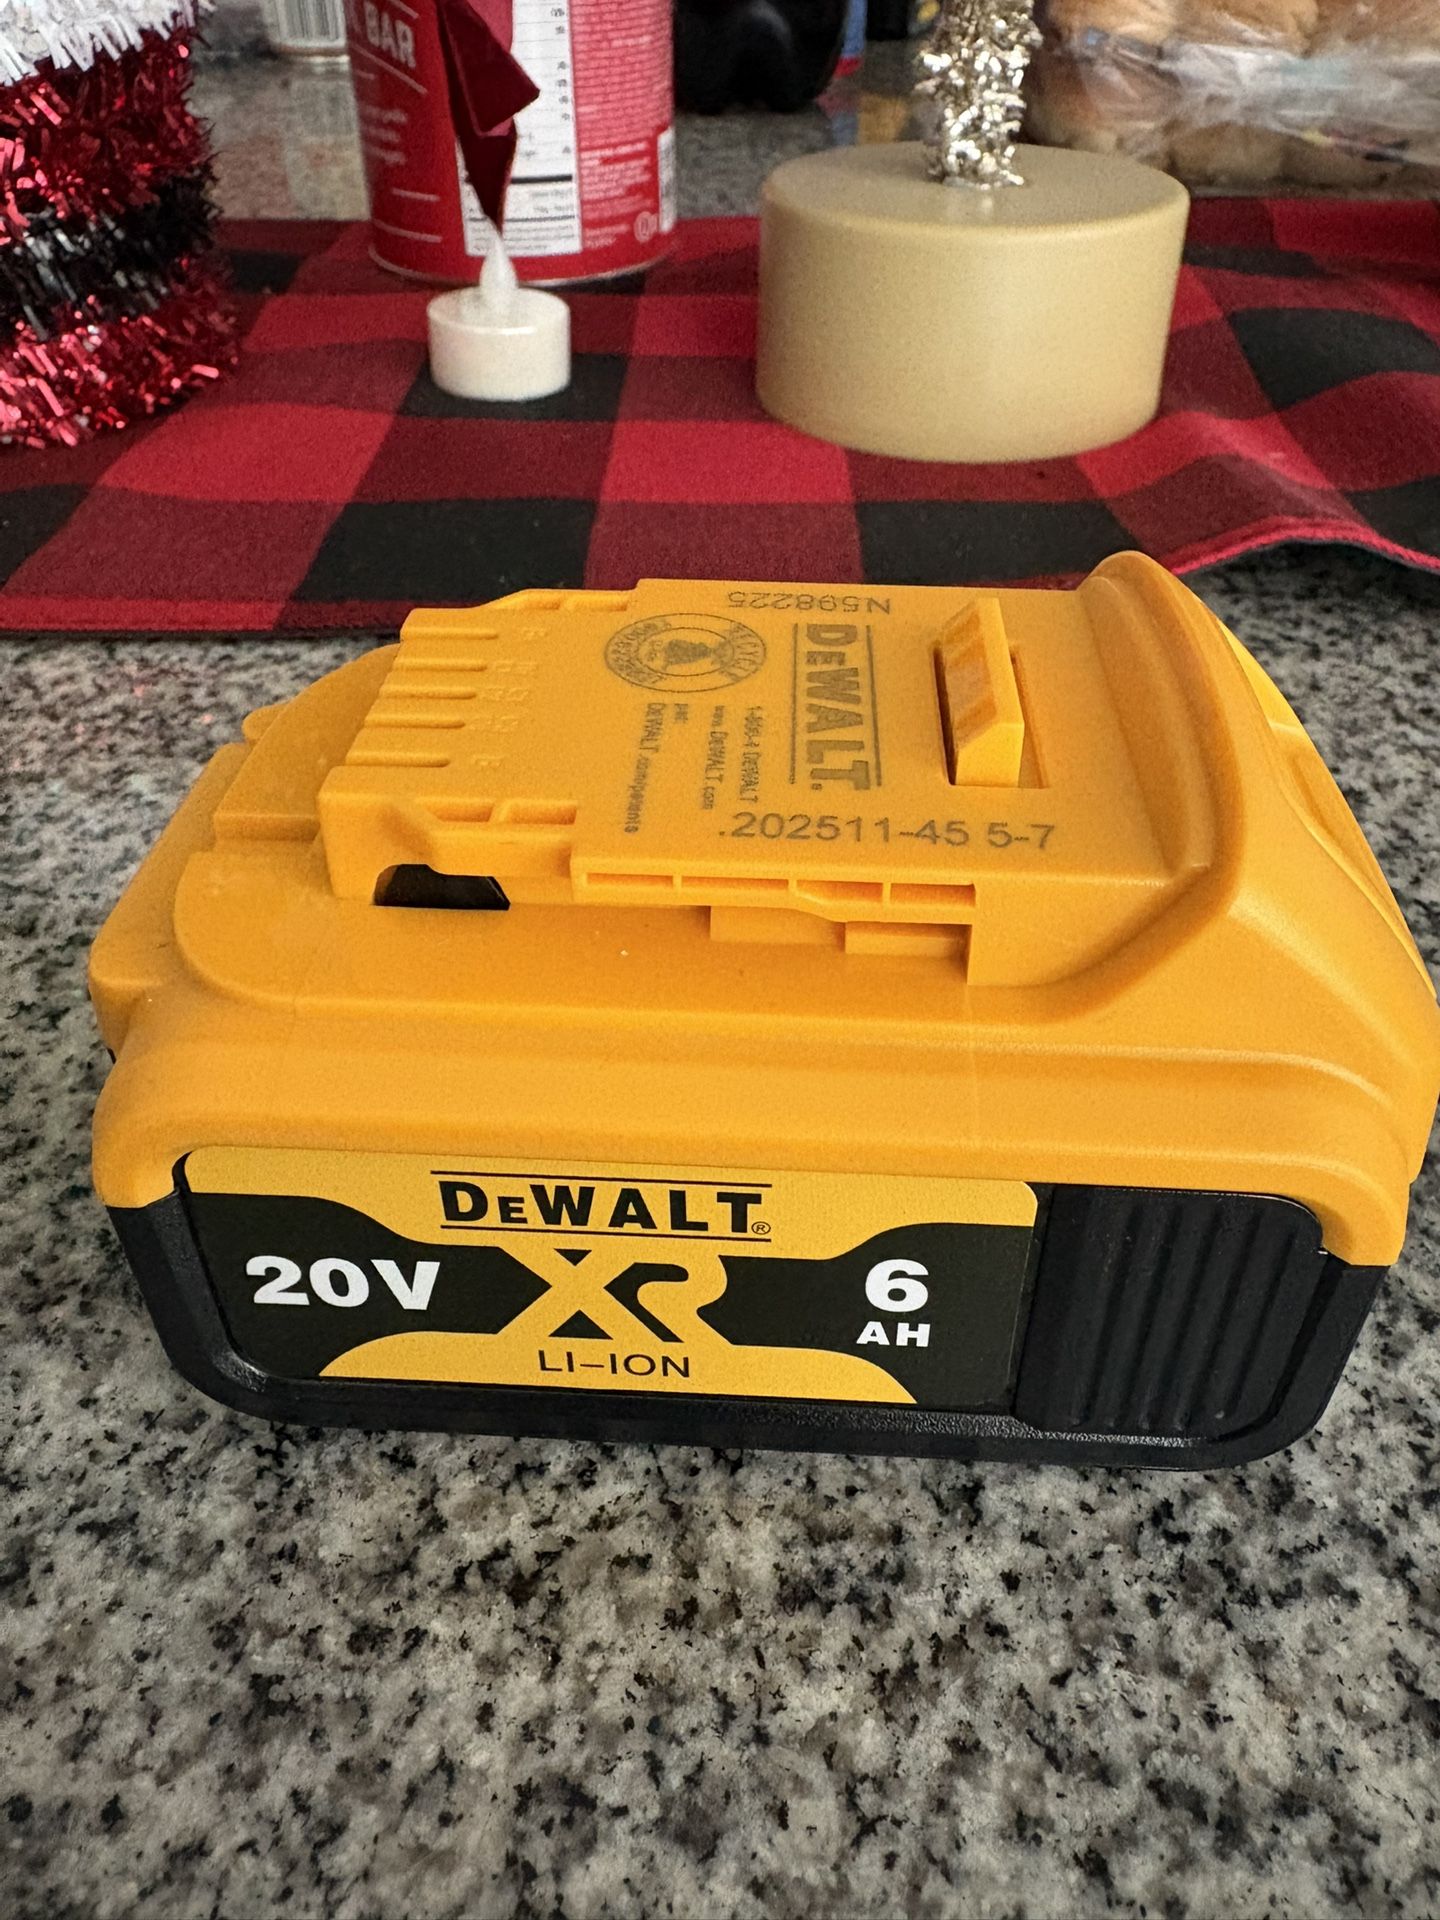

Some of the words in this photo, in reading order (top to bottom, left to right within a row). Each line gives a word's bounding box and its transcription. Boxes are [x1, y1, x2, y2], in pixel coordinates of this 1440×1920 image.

[363, 0, 416, 68] BAR
[728, 591, 890, 614] N598225
[988, 821, 1055, 850] 5-7
[245, 1255, 441, 1311] 20V
[494, 1247, 736, 1345] XR
[865, 1258, 929, 1312] 6
[856, 1320, 931, 1348] AH
[538, 1349, 690, 1378] LI-ION
